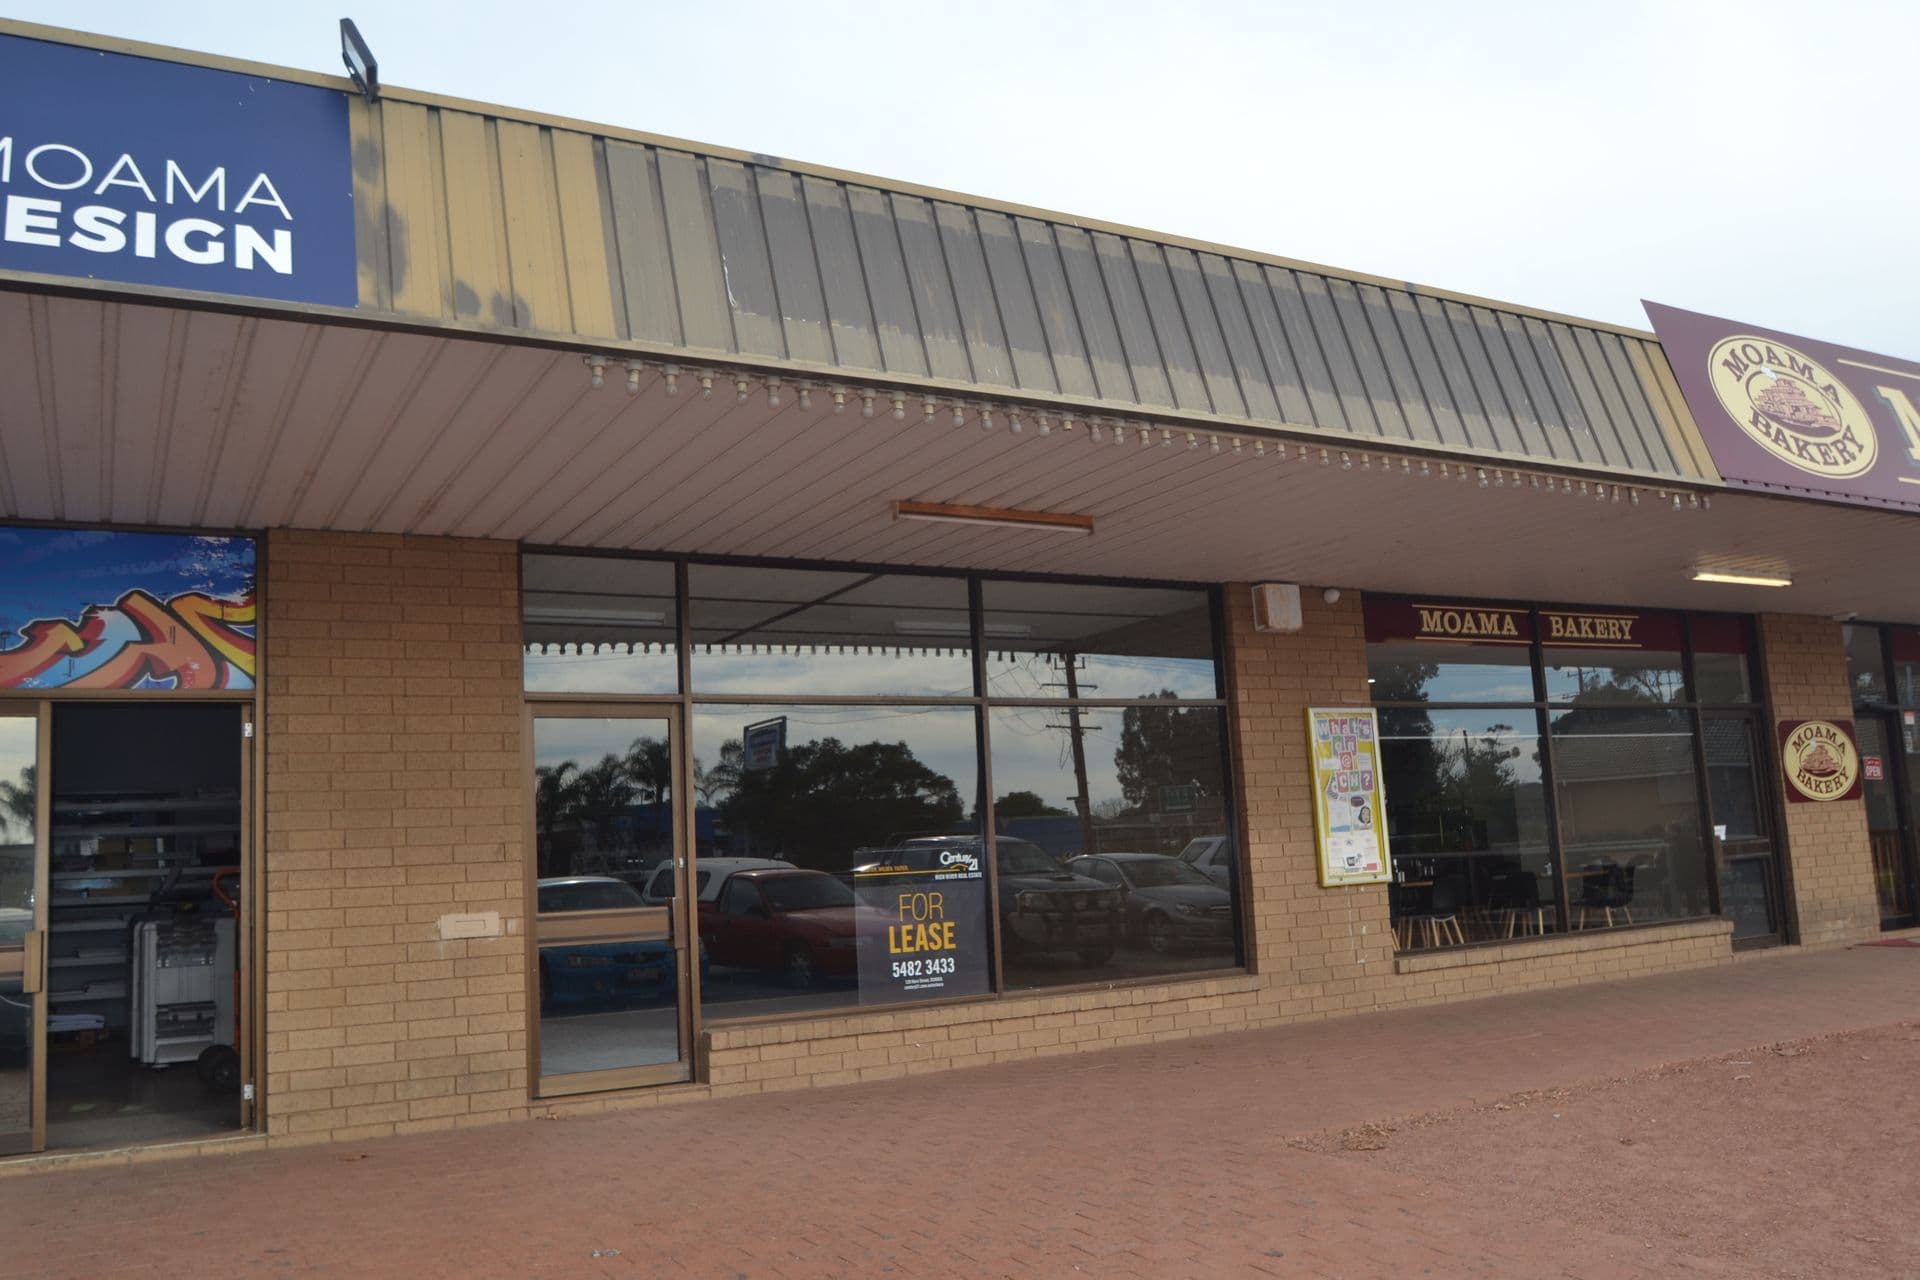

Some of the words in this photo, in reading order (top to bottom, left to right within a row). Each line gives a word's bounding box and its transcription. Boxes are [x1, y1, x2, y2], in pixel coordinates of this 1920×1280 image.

[0, 136, 293, 221] OAMA
[1722, 343, 1844, 410] MOAMA
[1748, 406, 1865, 467] BAKERY
[1420, 609, 1518, 636] MOAMA
[1549, 615, 1633, 640] BAKERY
[1791, 726, 1847, 756] MOAMA
[1795, 766, 1850, 794] BAKERY
[1865, 765, 1881, 777] OPEN
[939, 851, 973, 866] Century
[968, 858, 979, 871] 21
[898, 892, 944, 922] FOR
[888, 921, 957, 954] LEASE
[892, 960, 922, 978] 5482
[925, 957, 956, 974] 3433
